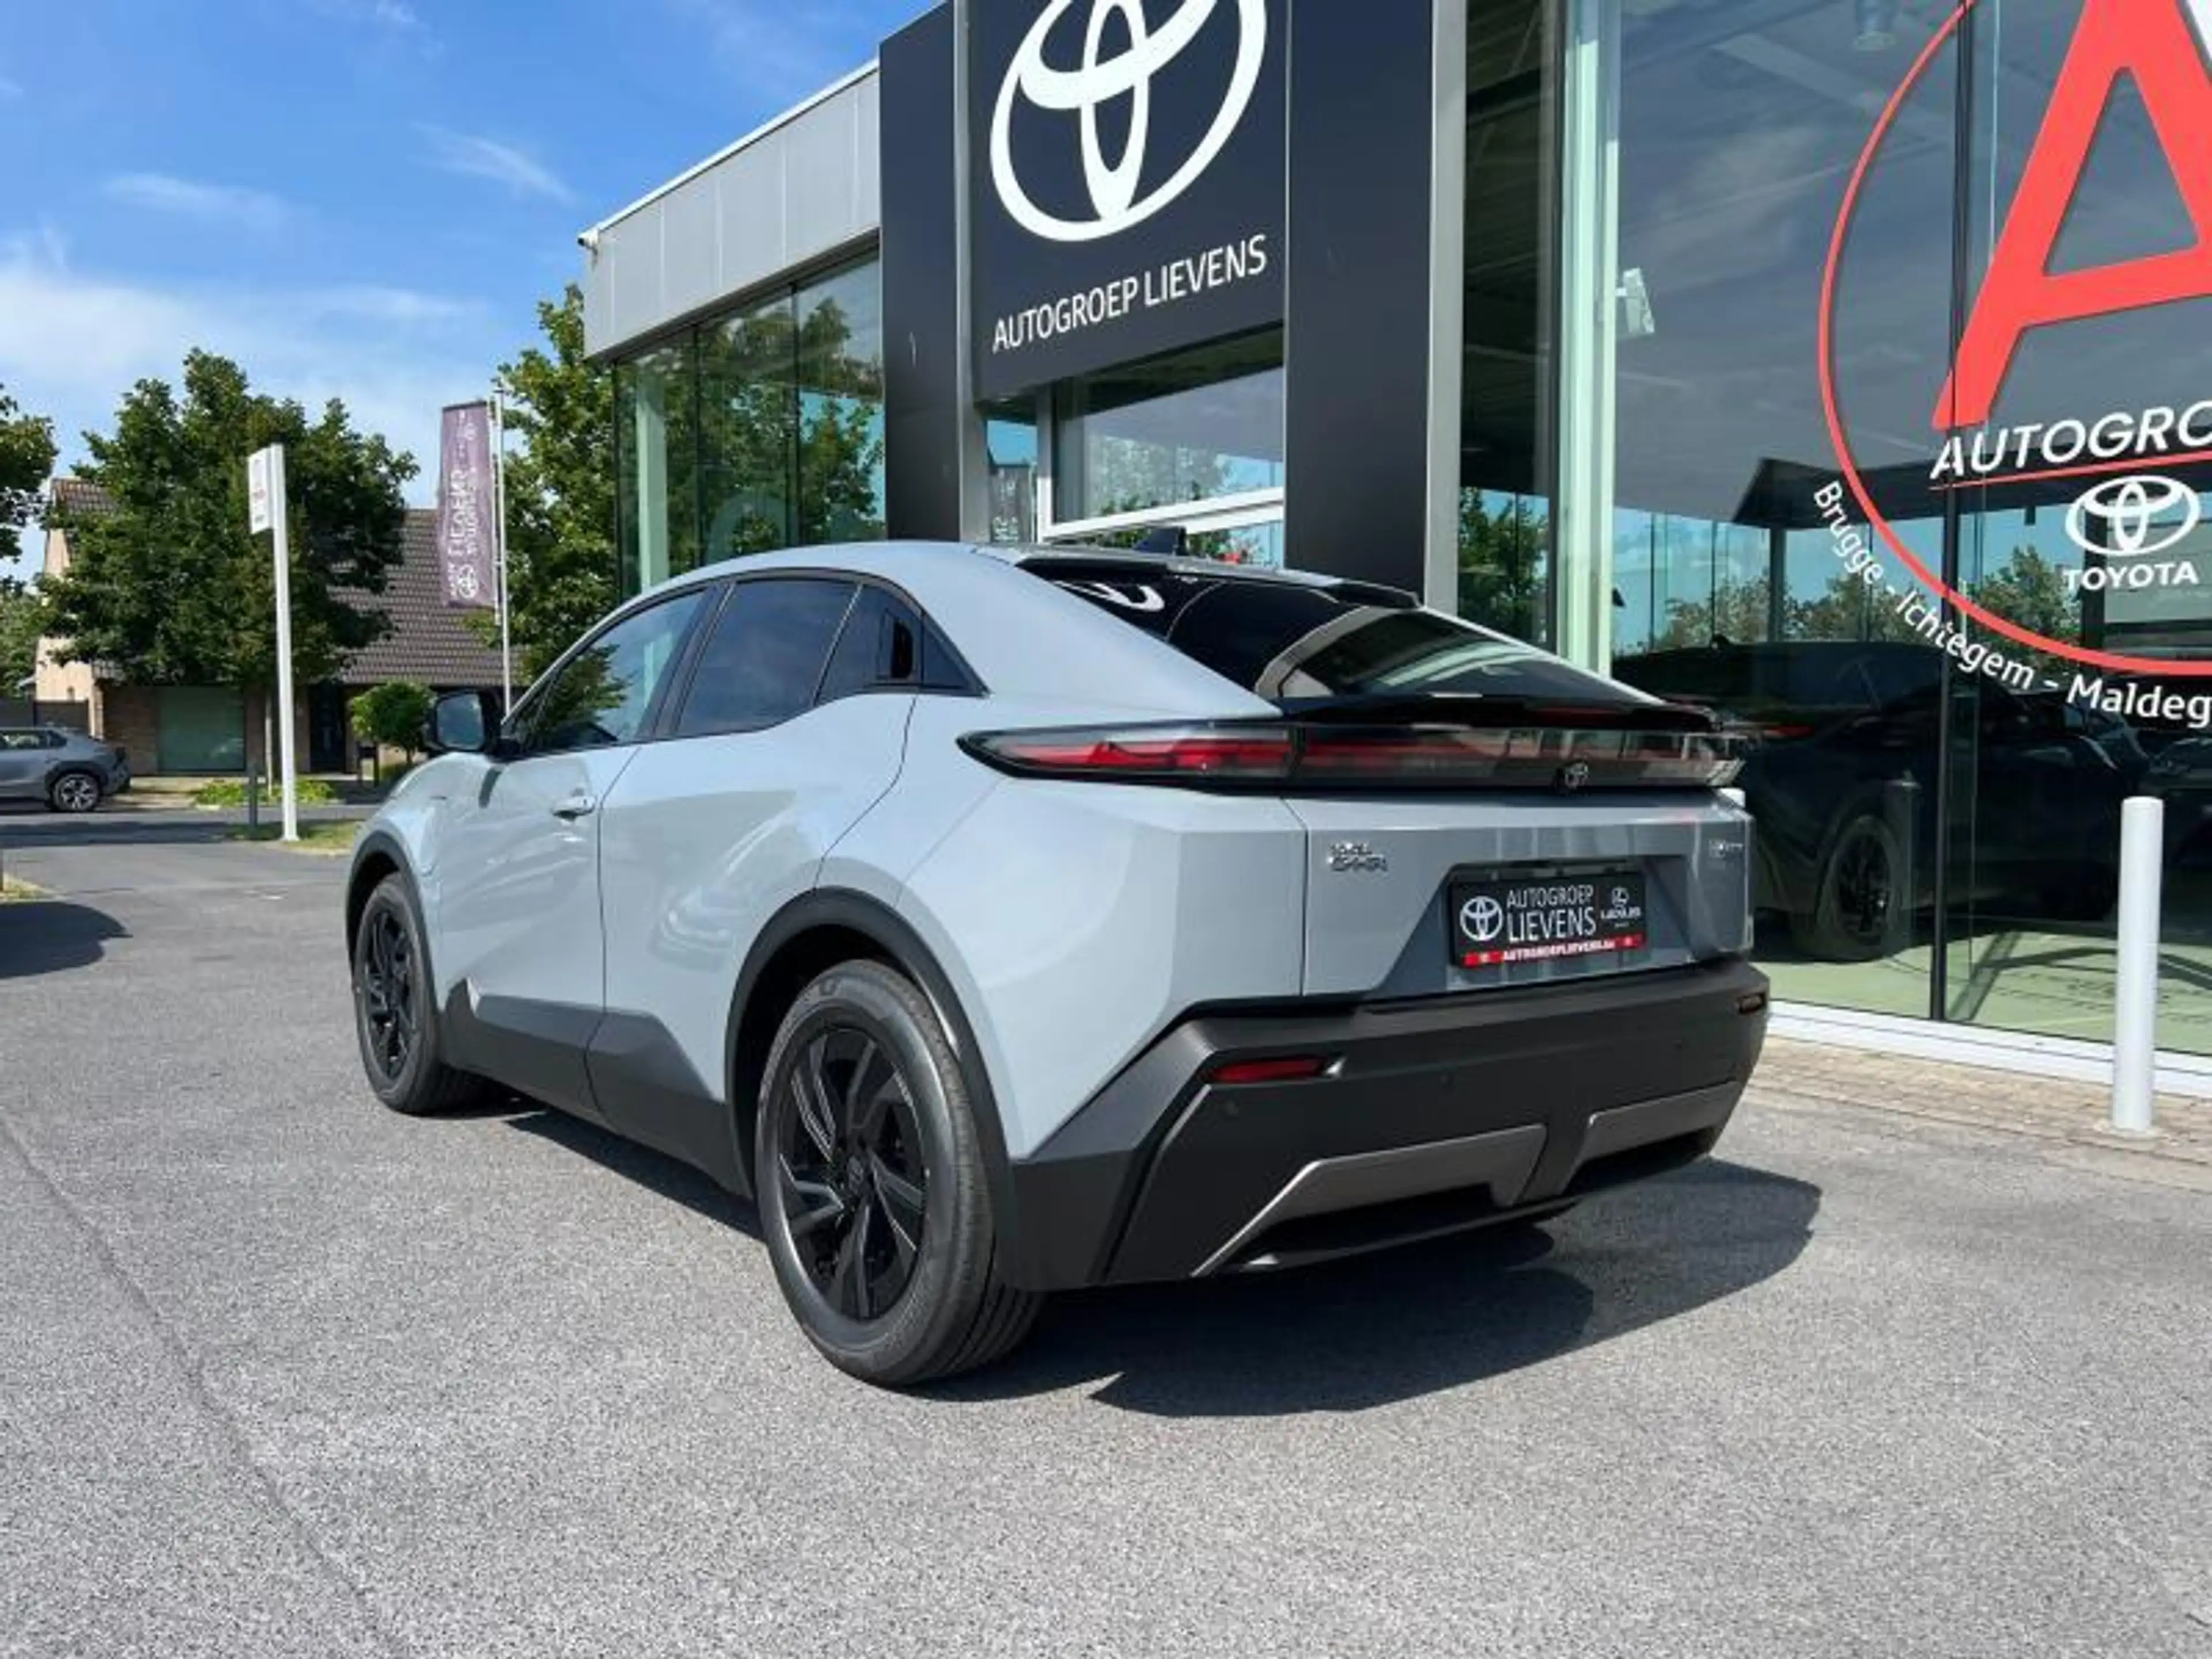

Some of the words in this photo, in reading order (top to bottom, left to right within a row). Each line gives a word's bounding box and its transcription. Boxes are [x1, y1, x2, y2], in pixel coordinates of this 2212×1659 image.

[992, 276, 1138, 354] AUTOGROEP
[1144, 233, 1268, 306] LIEVENS
[2062, 560, 2199, 591] TOYOTA
[1813, 480, 1884, 583] Brugge
[1896, 590, 2035, 690] Ichtegem
[2066, 674, 2212, 728] Maldeg
[1506, 885, 1594, 908] AUTOGROEP
[1506, 907, 1597, 944] LIEVENS
